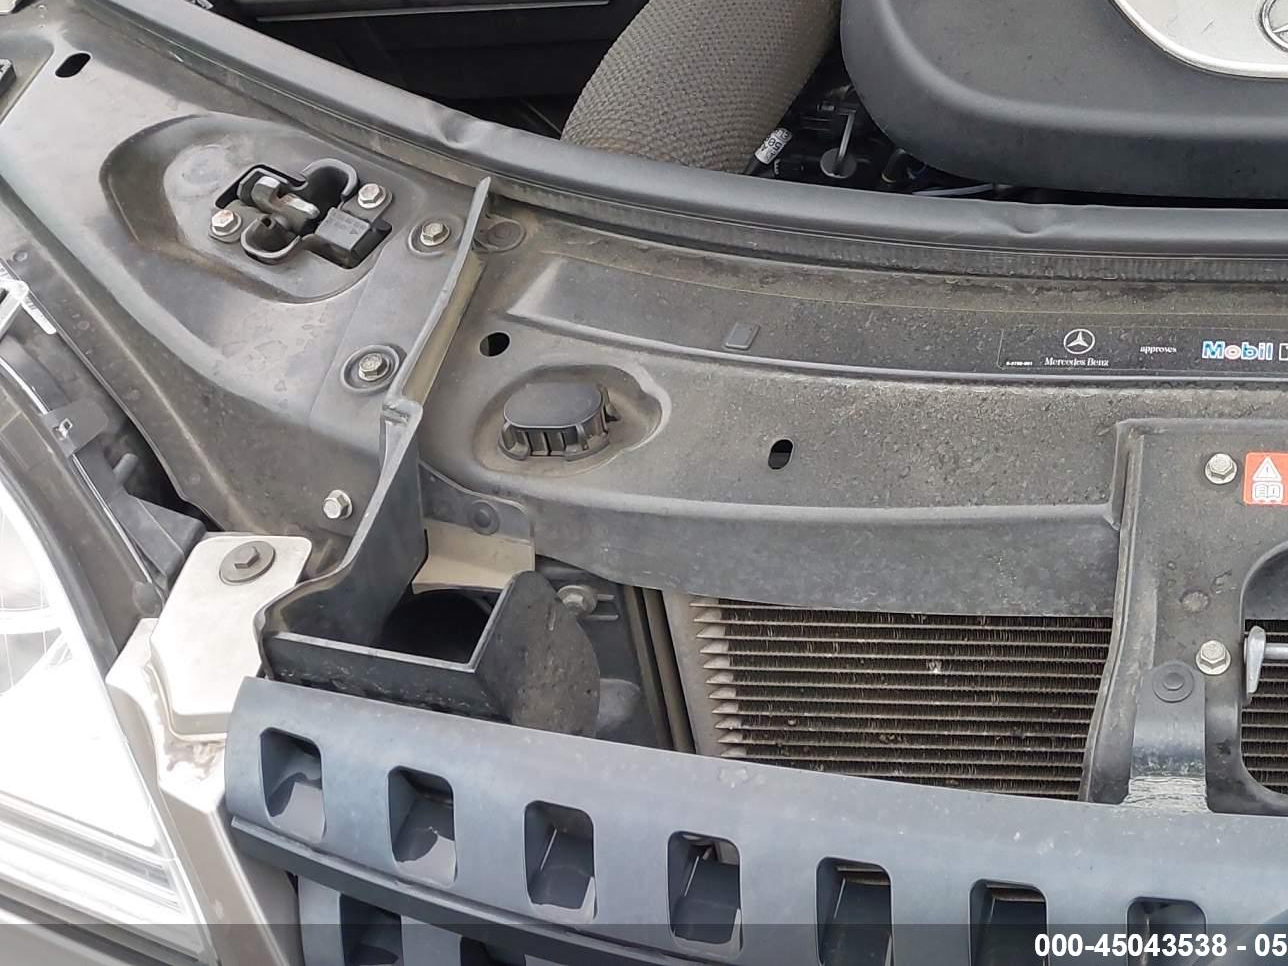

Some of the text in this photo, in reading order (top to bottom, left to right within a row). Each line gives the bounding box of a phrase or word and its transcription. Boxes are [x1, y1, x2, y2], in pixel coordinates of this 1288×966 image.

[1139, 346, 1177, 354] approves
[1202, 341, 1273, 361] Mobil
[1044, 357, 1086, 367] Mercedes
[1087, 357, 1109, 367] Benz
